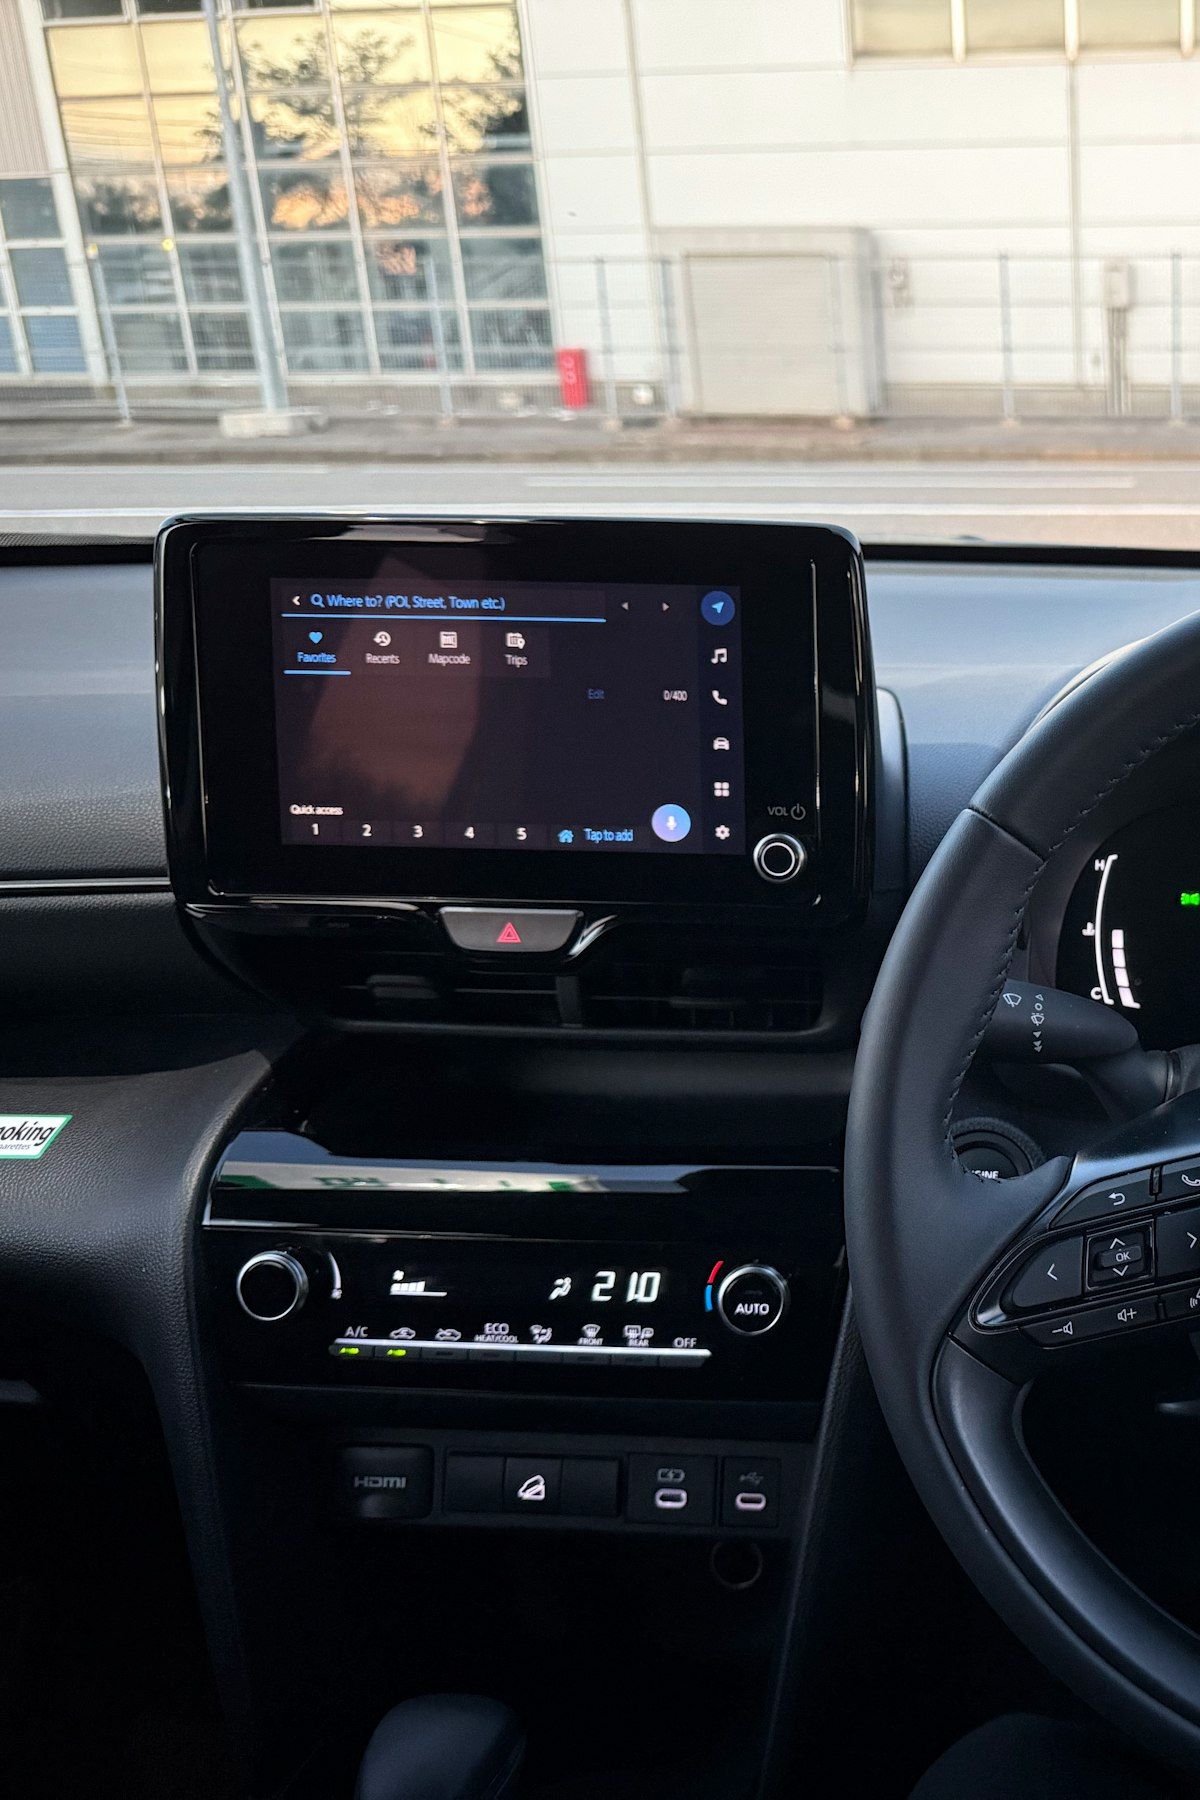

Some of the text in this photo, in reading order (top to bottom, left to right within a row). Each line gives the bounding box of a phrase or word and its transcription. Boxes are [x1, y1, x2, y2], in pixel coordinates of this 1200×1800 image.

[327, 594, 363, 608] Where
[365, 594, 383, 608] to?
[412, 595, 446, 609] Street,
[450, 596, 479, 609] Town
[297, 652, 337, 663] Favorites
[365, 653, 400, 665] Recents
[428, 653, 471, 666] Mapcode
[505, 654, 528, 667] Trips
[663, 689, 688, 701] 0/400
[290, 804, 343, 815] Quick access
[767, 806, 788, 816] VOL
[311, 823, 320, 835] 1
[362, 823, 372, 837] 2
[412, 825, 424, 838] 3
[464, 826, 475, 839] 4
[516, 827, 527, 840] 5
[583, 828, 634, 844] Tap to add
[1094, 859, 1105, 871] H
[1090, 986, 1102, 1000] C
[1115, 1251, 1131, 1262] OK
[734, 1302, 770, 1315] AUTO
[344, 1325, 369, 1338] A/C
[484, 1322, 510, 1335] ECO
[474, 1334, 519, 1343] HEAT/COOL
[578, 1337, 604, 1346] FRONT
[628, 1338, 650, 1347] REAR
[673, 1337, 698, 1348] OFF
[353, 1476, 407, 1489] HDMI
